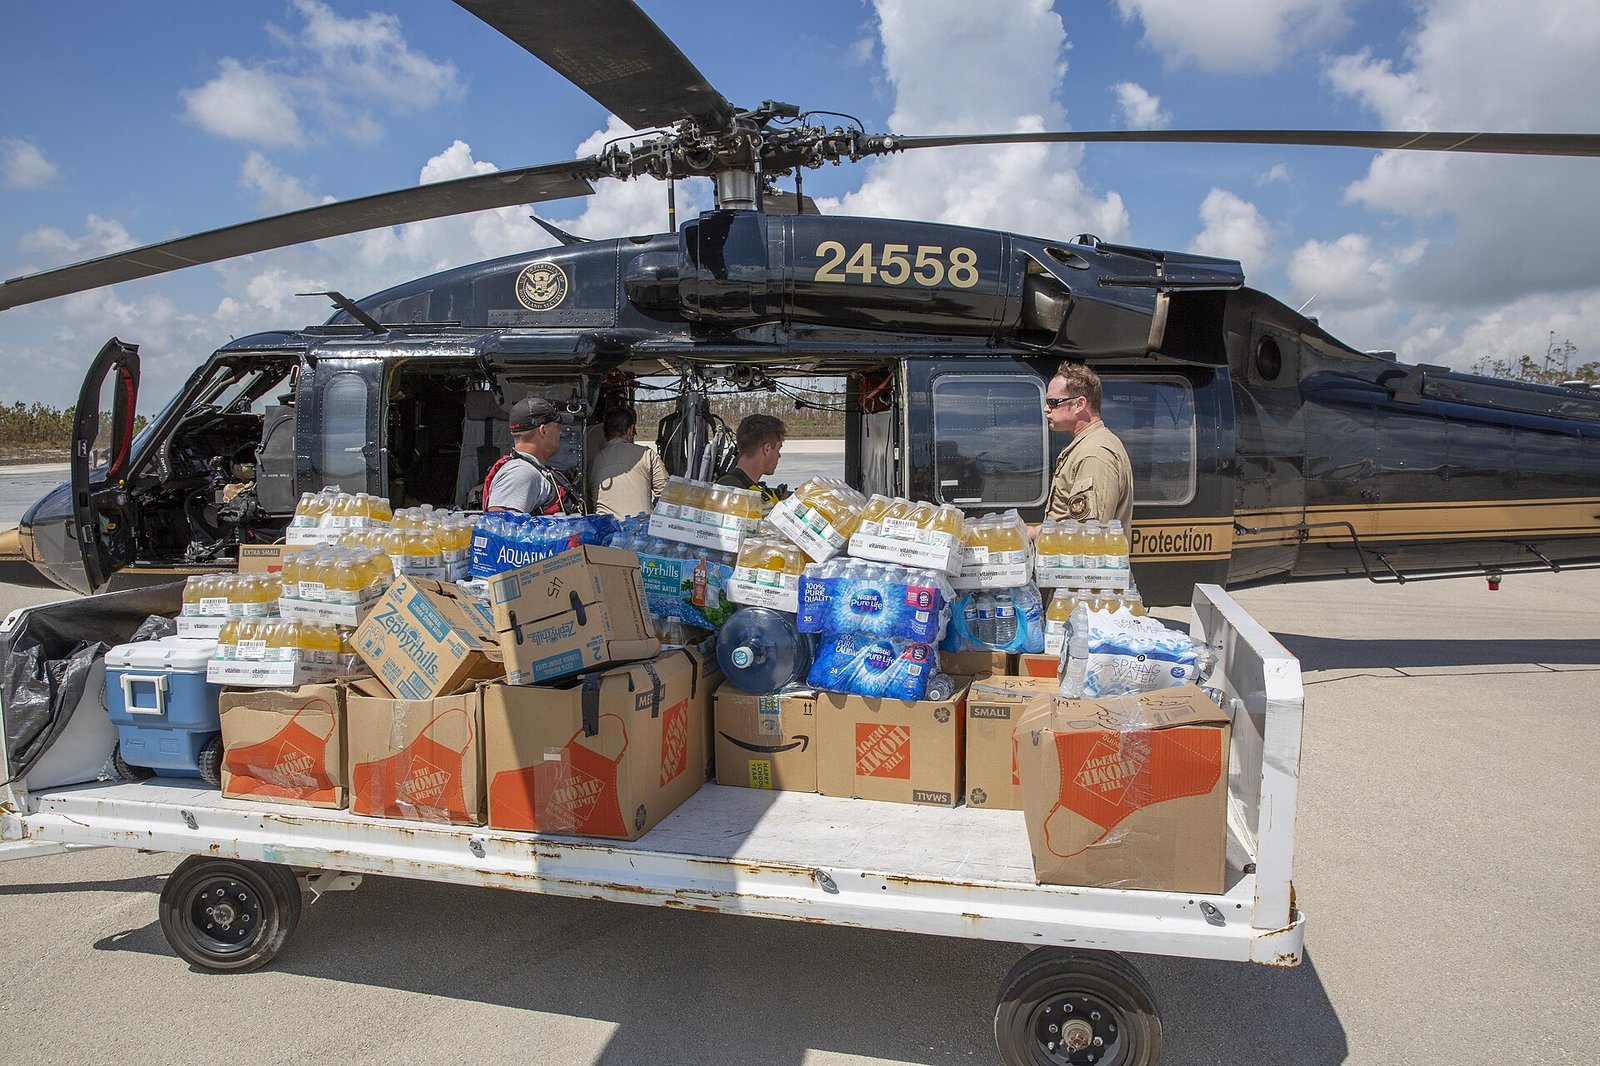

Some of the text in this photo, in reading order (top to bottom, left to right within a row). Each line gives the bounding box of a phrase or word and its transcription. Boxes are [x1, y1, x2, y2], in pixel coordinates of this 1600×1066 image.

[527, 265, 561, 276] DEPARTMENT
[815, 240, 979, 288] 24558
[519, 288, 564, 309] HOMELAND SECURITY
[1130, 528, 1212, 553] Protection
[869, 542, 897, 551] vitaminwater
[899, 547, 929, 556] vitaminwater
[695, 569, 706, 577] 24
[396, 583, 407, 594] 2
[547, 577, 564, 599] 45
[806, 582, 825, 591] 100%
[871, 600, 882, 610] Life
[427, 611, 443, 628] NATURAL
[374, 602, 438, 675] Zephyrhills
[531, 621, 576, 646] Zephyrhills
[837, 640, 854, 649] PURA
[593, 646, 601, 660] 2
[866, 653, 882, 661] Pure
[1112, 659, 1161, 674] SPRING
[1113, 668, 1158, 682] WATER
[974, 708, 1007, 717] SMALL
[856, 724, 888, 756] DEPOT
[282, 752, 297, 761] THE
[858, 726, 910, 776] HOME
[275, 756, 312, 775] HOME
[882, 752, 905, 773] THE
[1086, 753, 1122, 769] DEPOT
[413, 768, 429, 778] THE
[1080, 760, 1135, 787] HOME
[403, 771, 447, 794] HOME
[565, 775, 582, 786] THE
[1101, 781, 1121, 792] THE
[415, 788, 443, 800] DEPOT
[555, 779, 601, 802] HOME
[915, 792, 948, 803] SMALL
[566, 796, 597, 810] DEPOT
